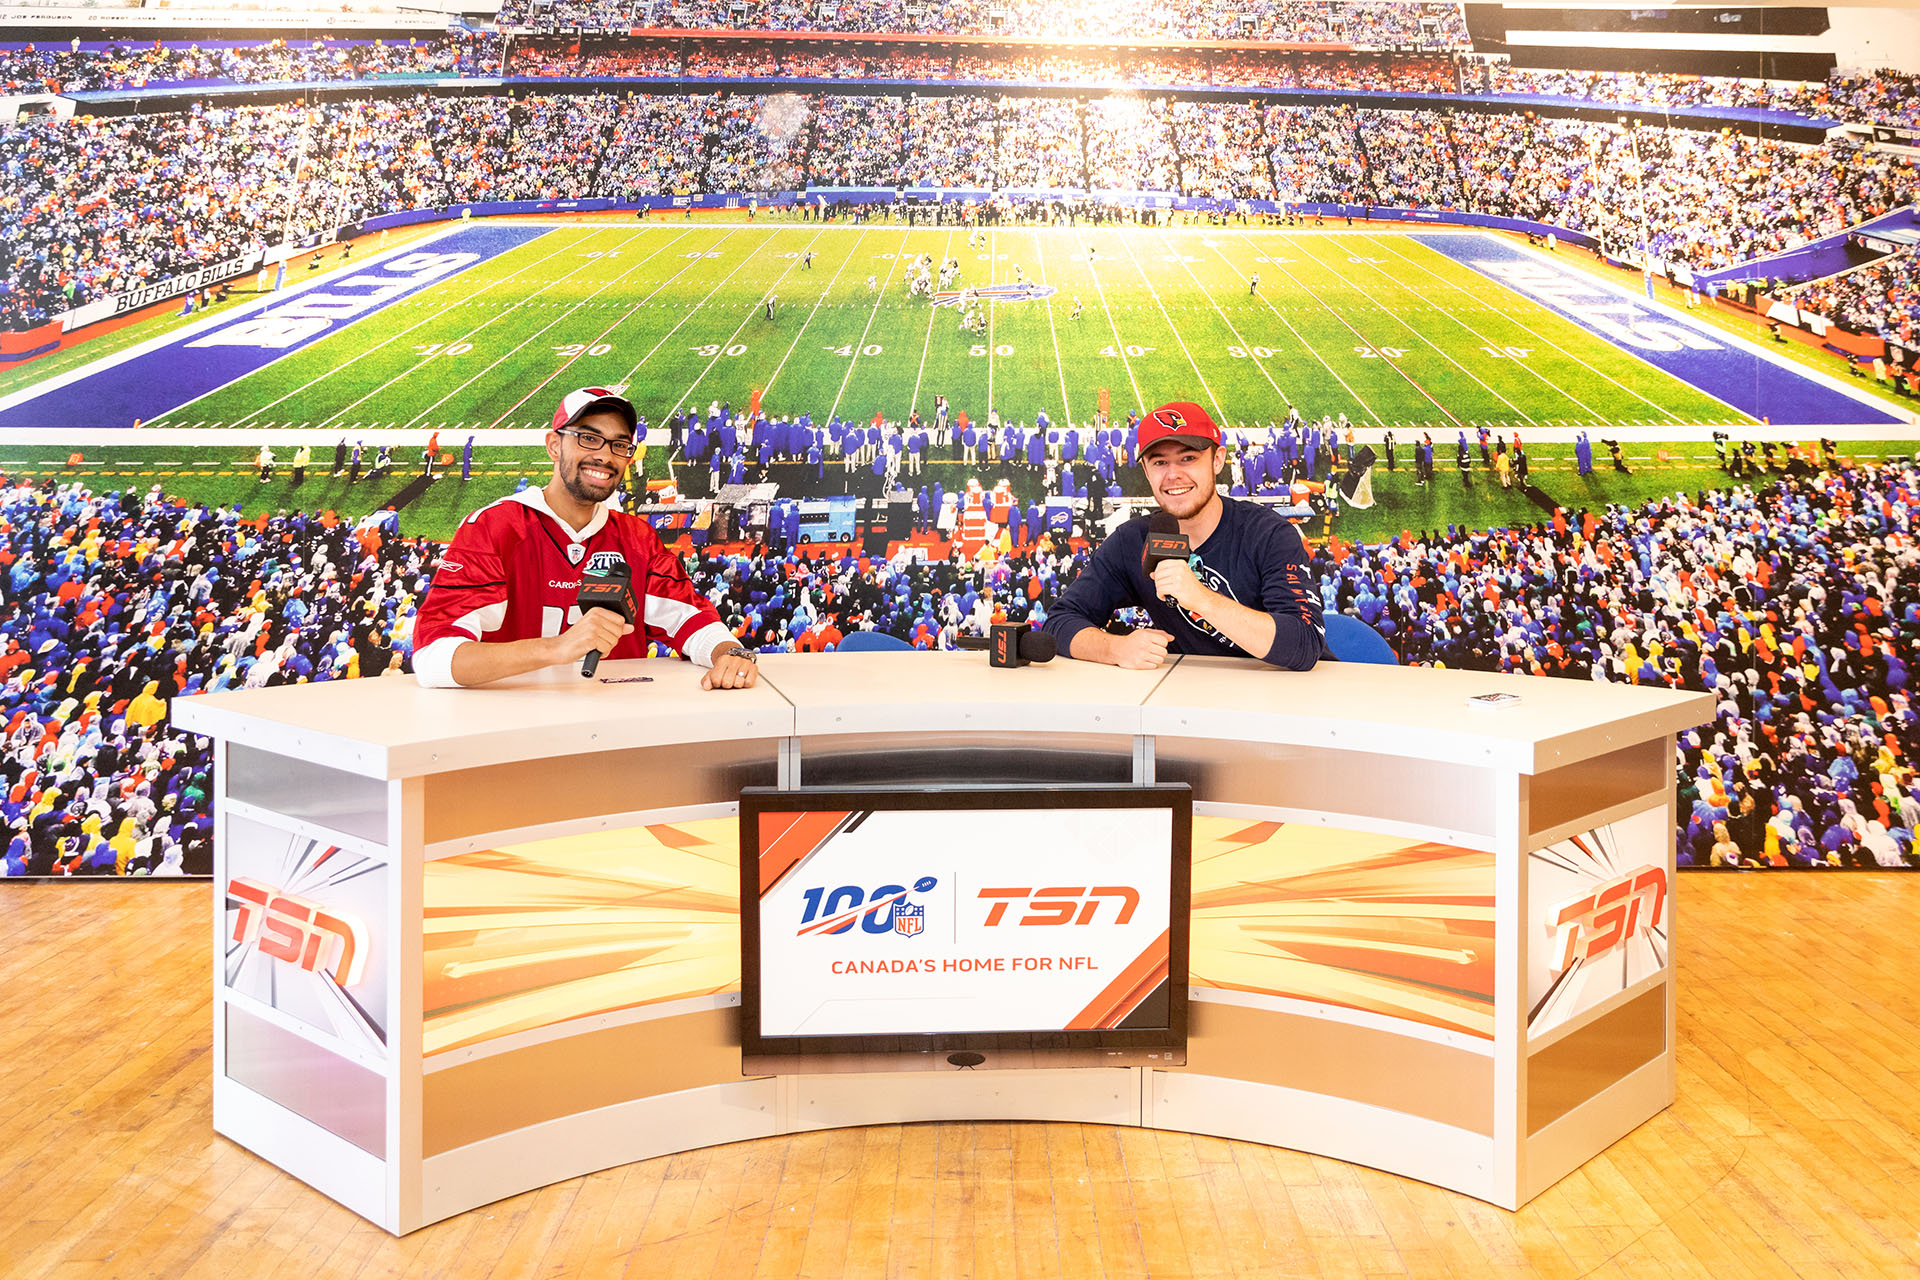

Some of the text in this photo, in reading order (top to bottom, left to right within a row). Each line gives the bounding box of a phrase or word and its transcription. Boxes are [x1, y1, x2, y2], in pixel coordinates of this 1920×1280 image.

[114, 258, 246, 313] BUFFALO BILLS
[183, 252, 481, 348] BILLS
[415, 343, 1527, 358] 10 20 30 40 50 40 30 20 10
[1151, 539, 1188, 550] TSN
[590, 557, 621, 570] XLI
[583, 583, 622, 593] TSN
[625, 588, 637, 617] TSN
[998, 630, 1007, 664] TSN
[798, 884, 907, 935] 100
[977, 886, 1140, 927] TSN
[1551, 865, 1667, 972] TSN
[228, 878, 363, 987] TSN
[896, 917, 922, 934] NFL
[831, 956, 1099, 975] CANADA'S HOME FOR NFL
